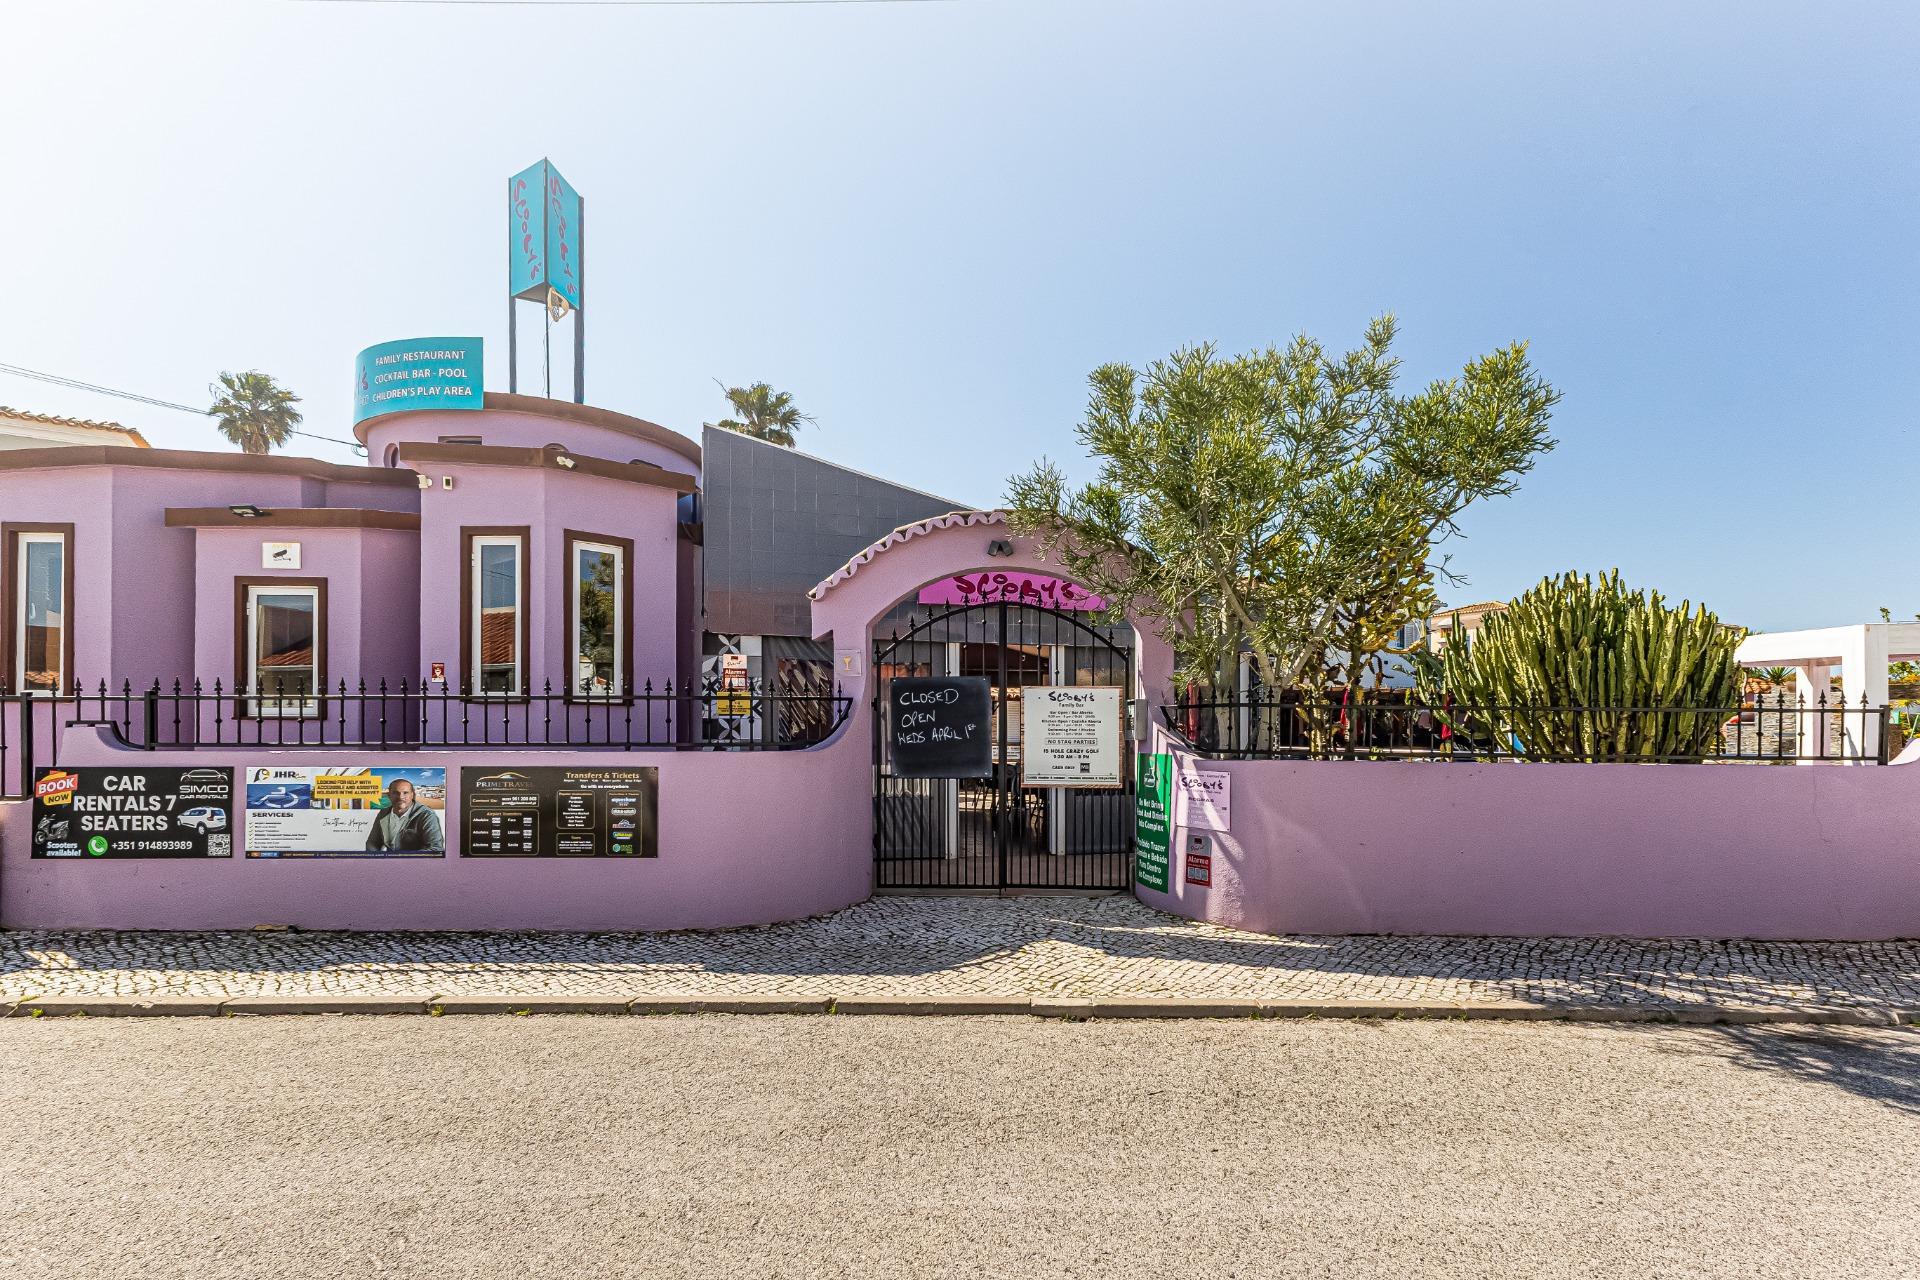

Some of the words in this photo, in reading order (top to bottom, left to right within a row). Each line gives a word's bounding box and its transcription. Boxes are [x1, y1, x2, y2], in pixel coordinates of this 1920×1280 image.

[375, 354, 401, 366] FAMILY
[403, 350, 466, 361] RESTAURANT
[375, 371, 410, 384] COCKTAIL
[412, 368, 431, 379] BAR
[438, 368, 468, 379] POOL
[372, 387, 416, 403] CHILDREN'S
[417, 386, 442, 397] PLAY
[443, 386, 473, 396] AREA
[899, 688, 960, 706] CLOSED
[901, 710, 936, 728] OPEN
[897, 730, 926, 746] WEDS
[273, 770, 296, 779] JHR
[37, 777, 76, 795] BOOK
[103, 775, 146, 792] CAR
[179, 785, 229, 793] SIMCO
[47, 792, 70, 804] NOW
[73, 795, 161, 812] RENTALS
[165, 795, 177, 812] 7
[1151, 801, 1164, 812] Bring
[1144, 809, 1152, 819] And
[81, 815, 169, 831] SEATERS
[1145, 820, 1164, 832] Complex
[47, 841, 78, 849] Scooters
[111, 841, 136, 850] +351
[138, 841, 193, 850] 914893989
[1151, 841, 1166, 852] Trazer
[46, 848, 82, 857] available!
[1151, 852, 1168, 865] Bebida
[1147, 861, 1162, 874] Dentro
